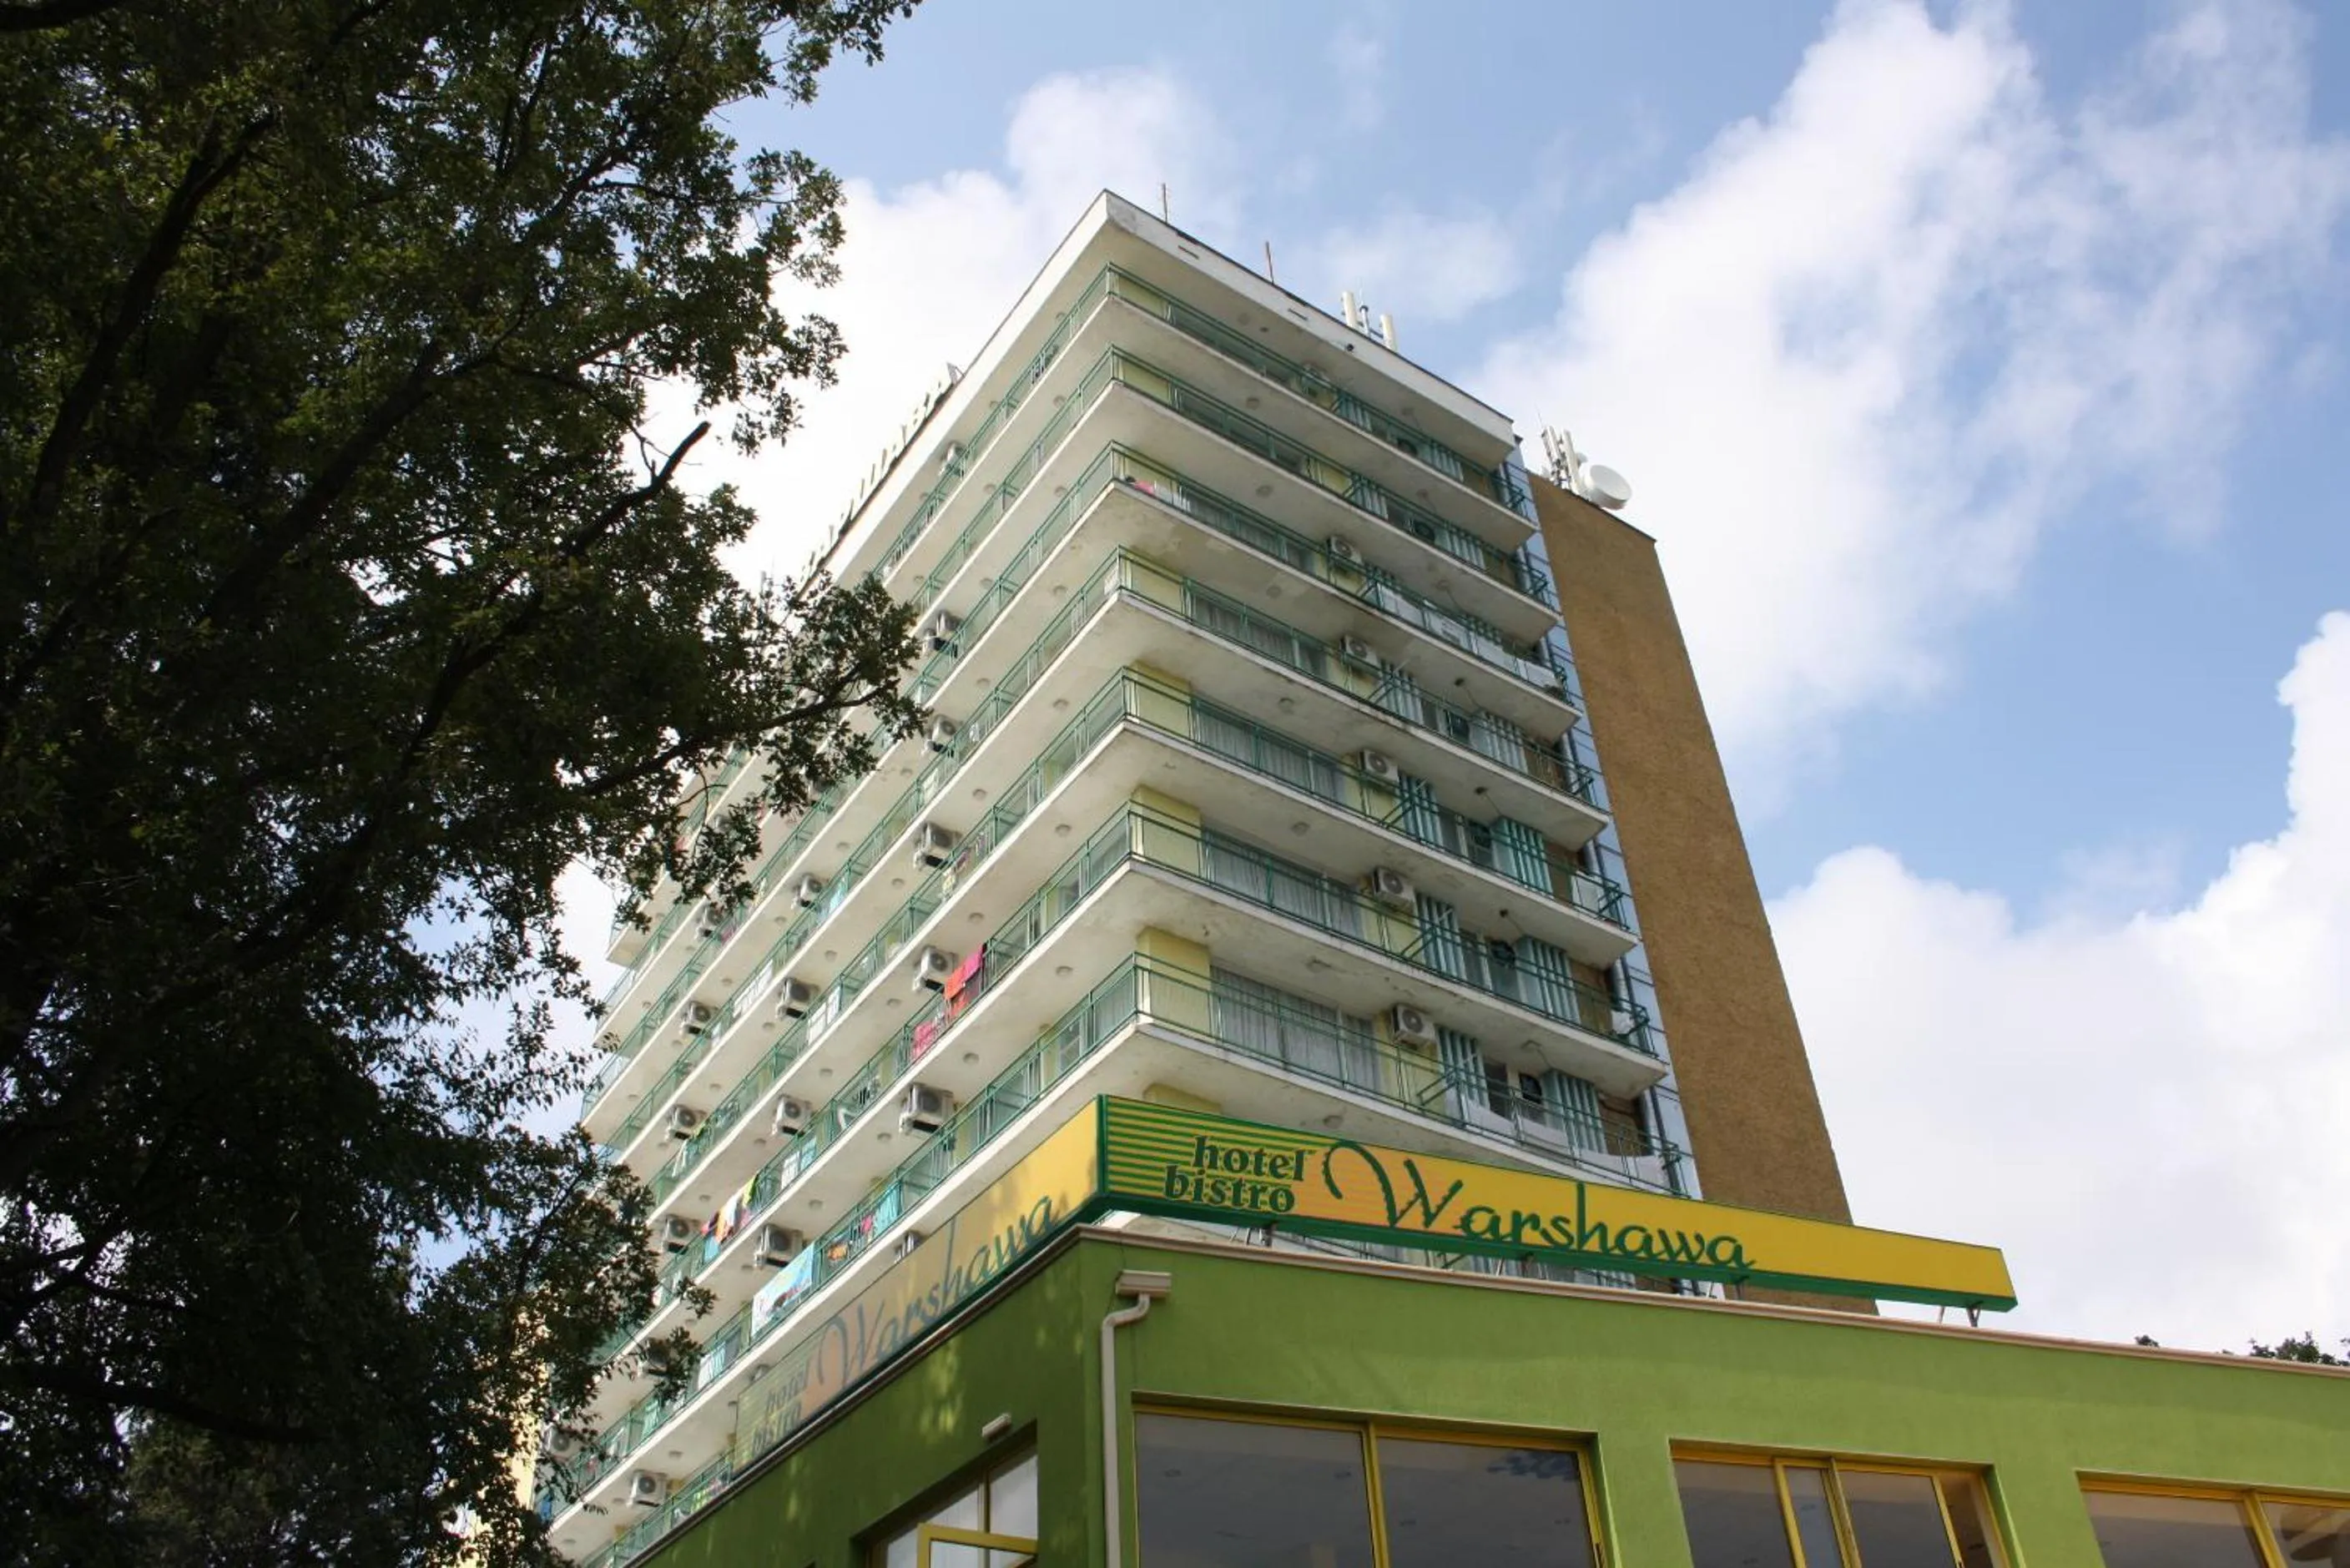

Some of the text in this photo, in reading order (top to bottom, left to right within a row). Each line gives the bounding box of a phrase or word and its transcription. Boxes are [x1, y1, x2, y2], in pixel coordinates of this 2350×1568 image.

[1164, 1164, 1295, 1213] bistro
[1193, 1135, 1305, 1182] hotel
[1322, 1139, 1756, 1270] Warshawa
[818, 1195, 1060, 1389] Warshawa
